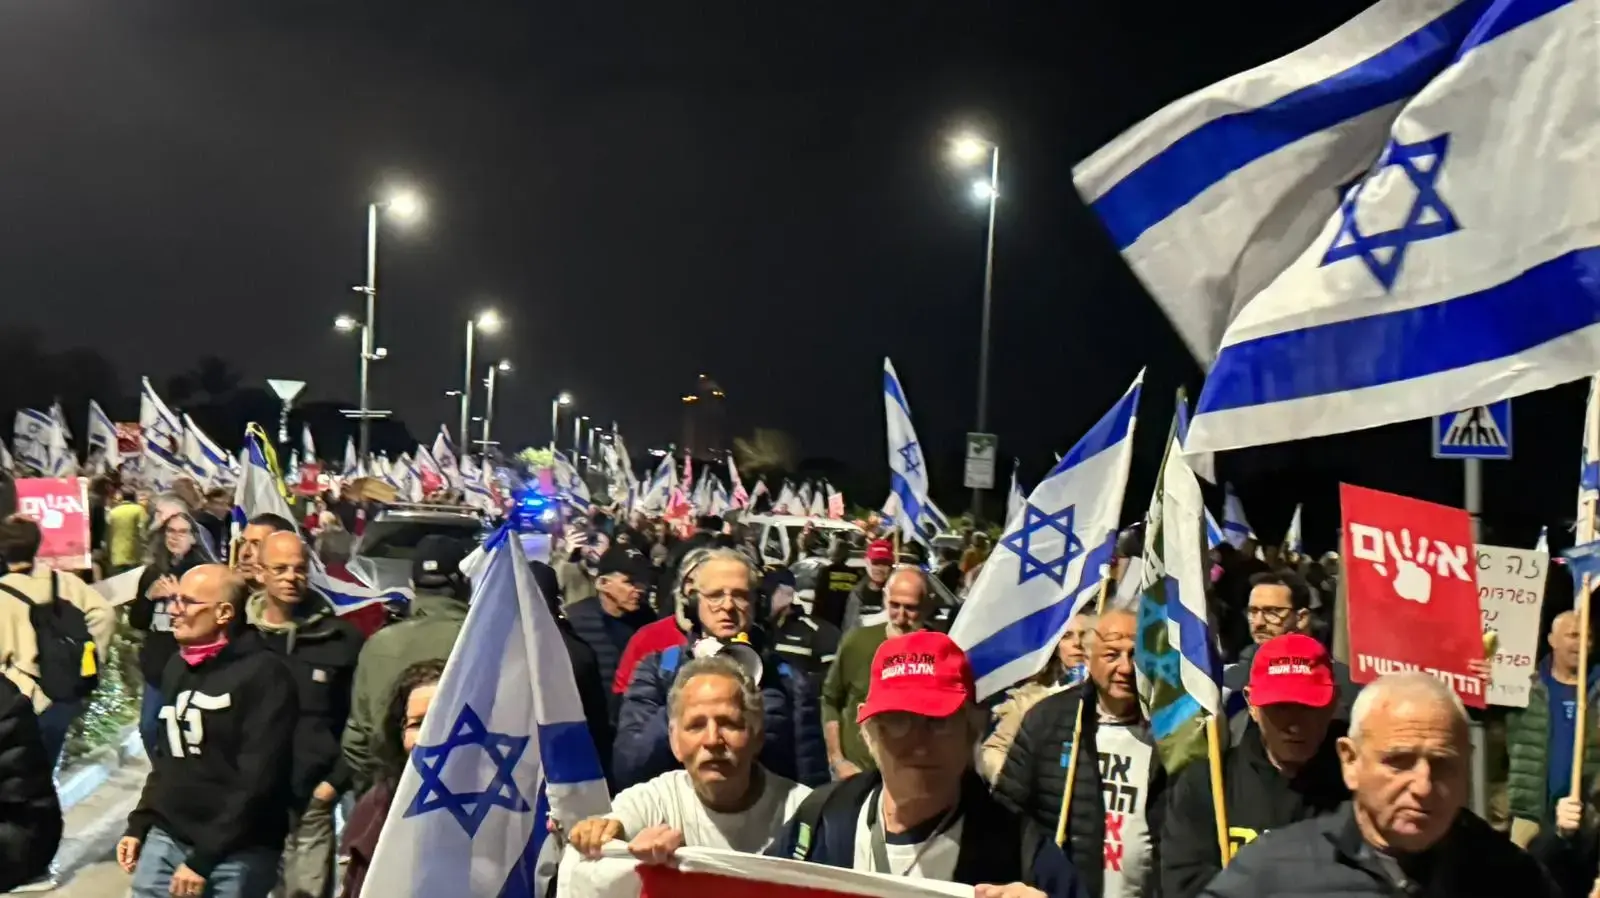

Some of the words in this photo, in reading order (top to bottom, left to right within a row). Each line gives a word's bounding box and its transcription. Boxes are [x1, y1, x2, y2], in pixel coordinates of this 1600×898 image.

[1506, 555, 1540, 579] זה
[1479, 587, 1537, 604] השרדות
[907, 663, 935, 676] אתה
